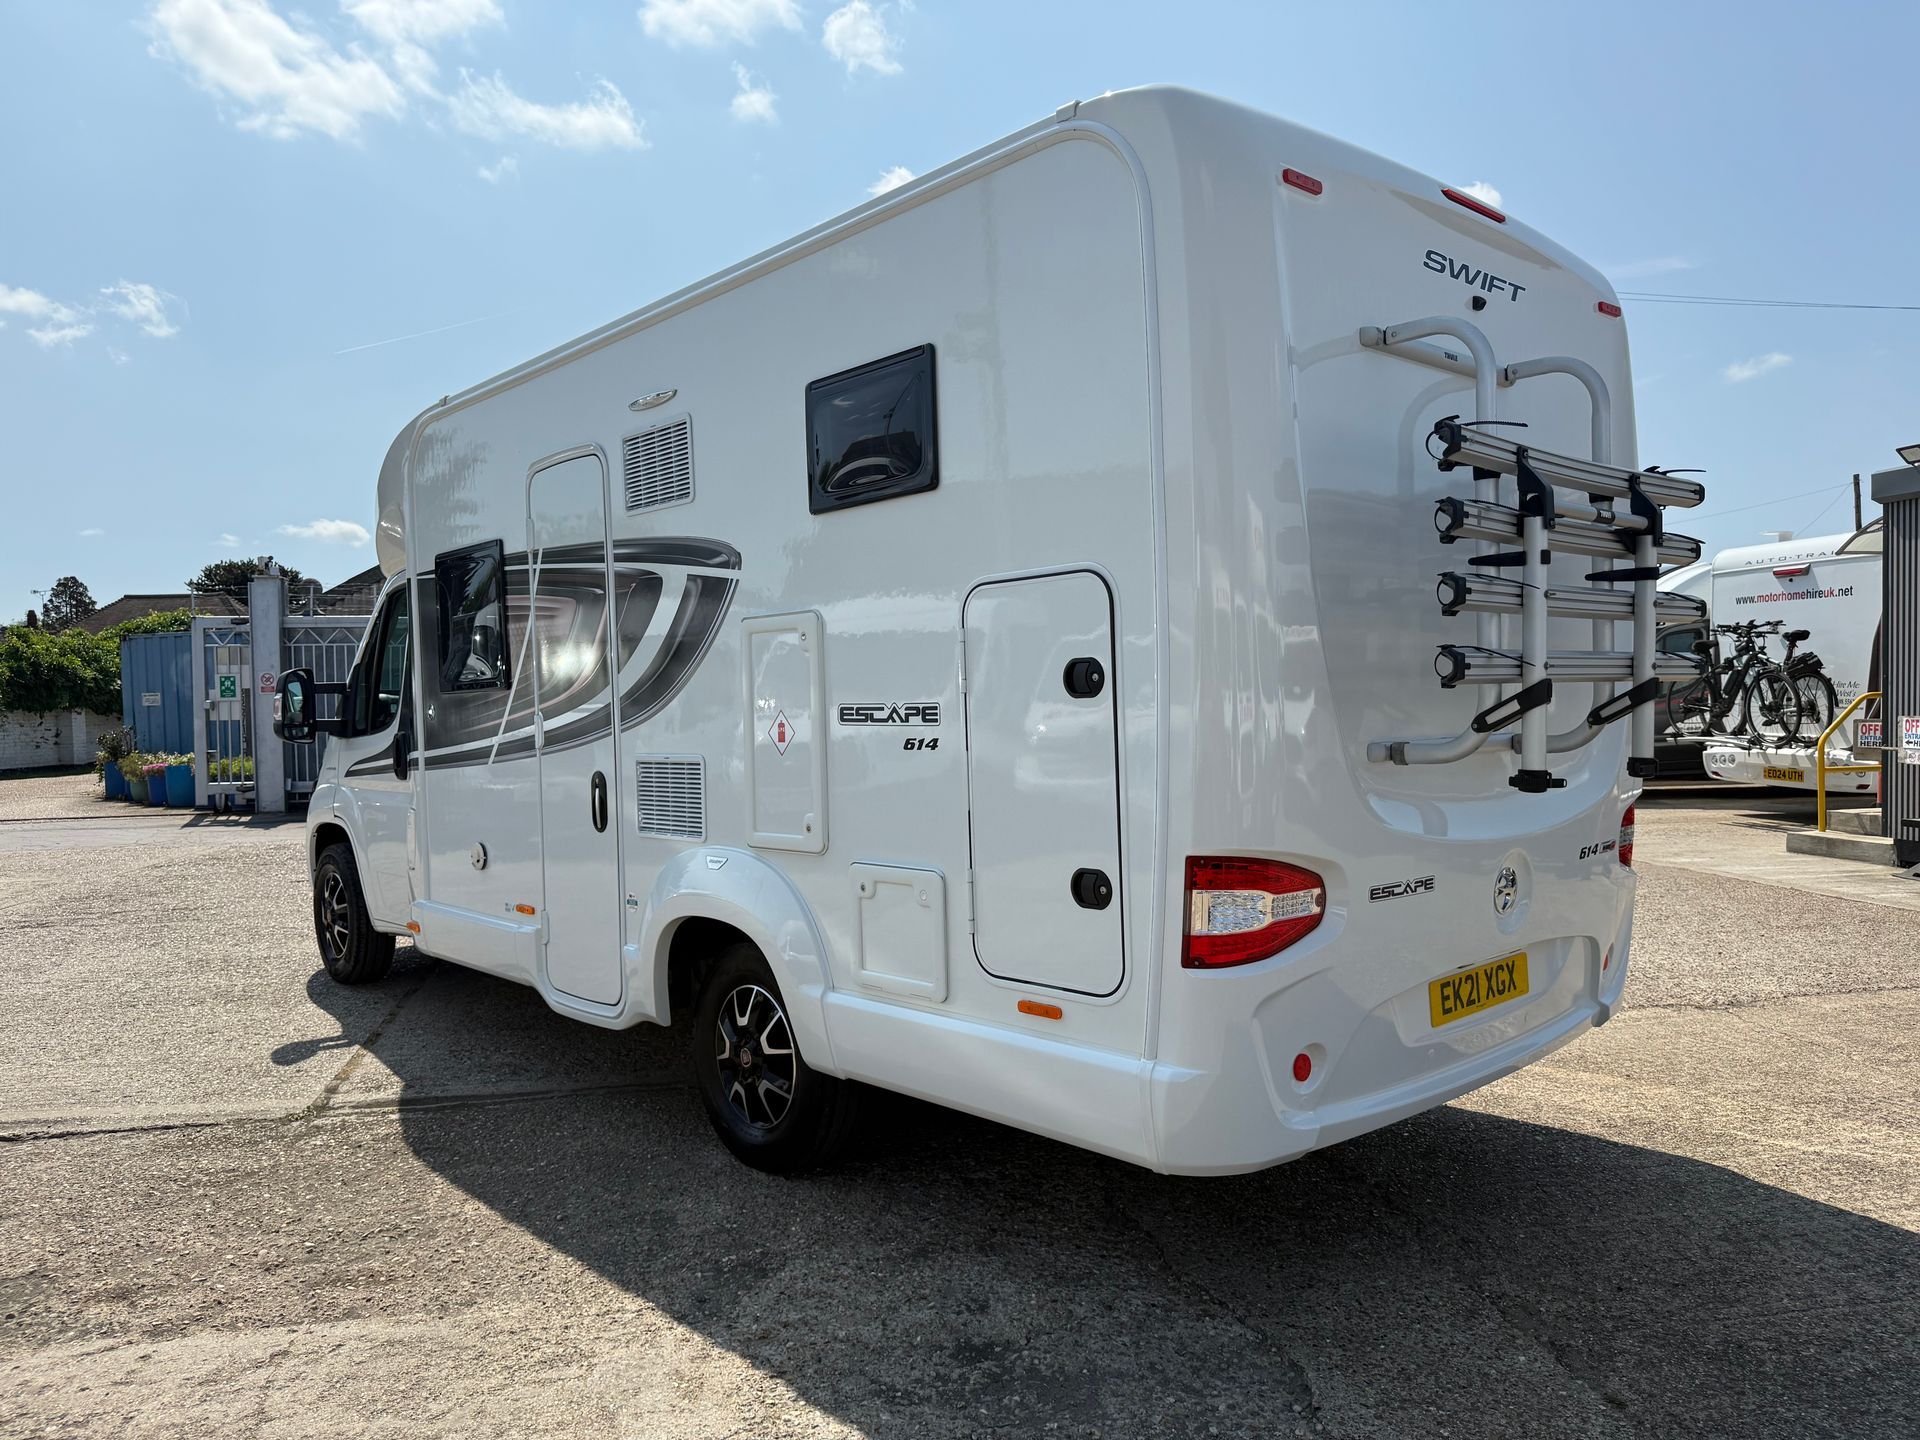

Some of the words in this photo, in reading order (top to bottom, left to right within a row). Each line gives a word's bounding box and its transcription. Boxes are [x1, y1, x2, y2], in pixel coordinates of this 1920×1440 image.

[1423, 249, 1526, 302] SWIFT
[1735, 585, 1853, 605] www.motorhomehireuk.net
[839, 705, 939, 723] ESCAPE
[903, 738, 939, 751] 614
[1579, 843, 1599, 860] 614
[1369, 877, 1434, 901] ESCAPE
[1440, 971, 1480, 1016] EK21
[1483, 960, 1517, 1000] XGX
